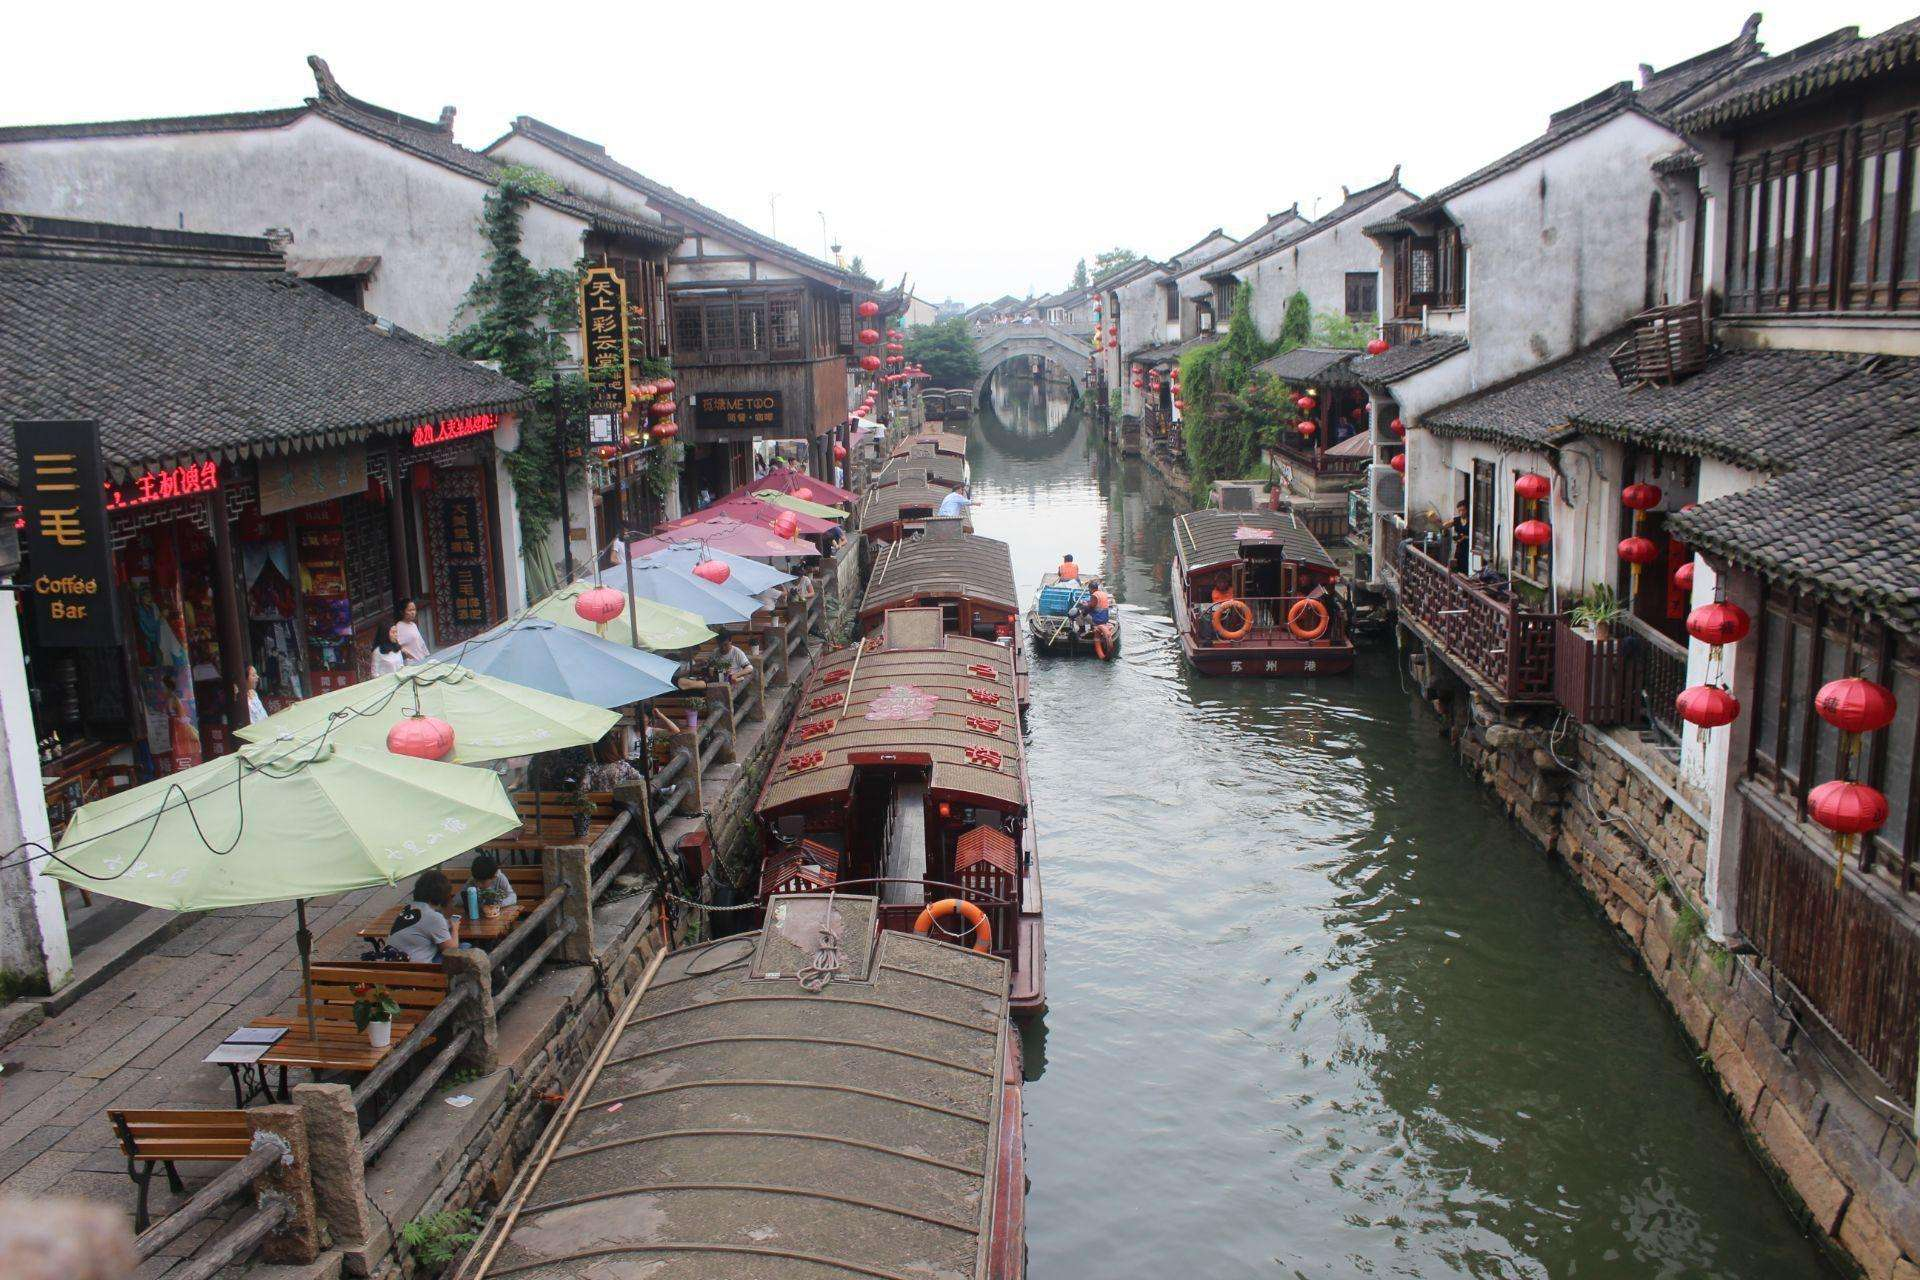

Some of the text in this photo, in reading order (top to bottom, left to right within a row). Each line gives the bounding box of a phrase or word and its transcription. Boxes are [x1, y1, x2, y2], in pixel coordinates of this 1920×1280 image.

[34, 454, 86, 545] 三毛
[35, 576, 98, 595] Coffee
[51, 601, 87, 620] Bar
[1231, 660, 1317, 673] 苏州港
